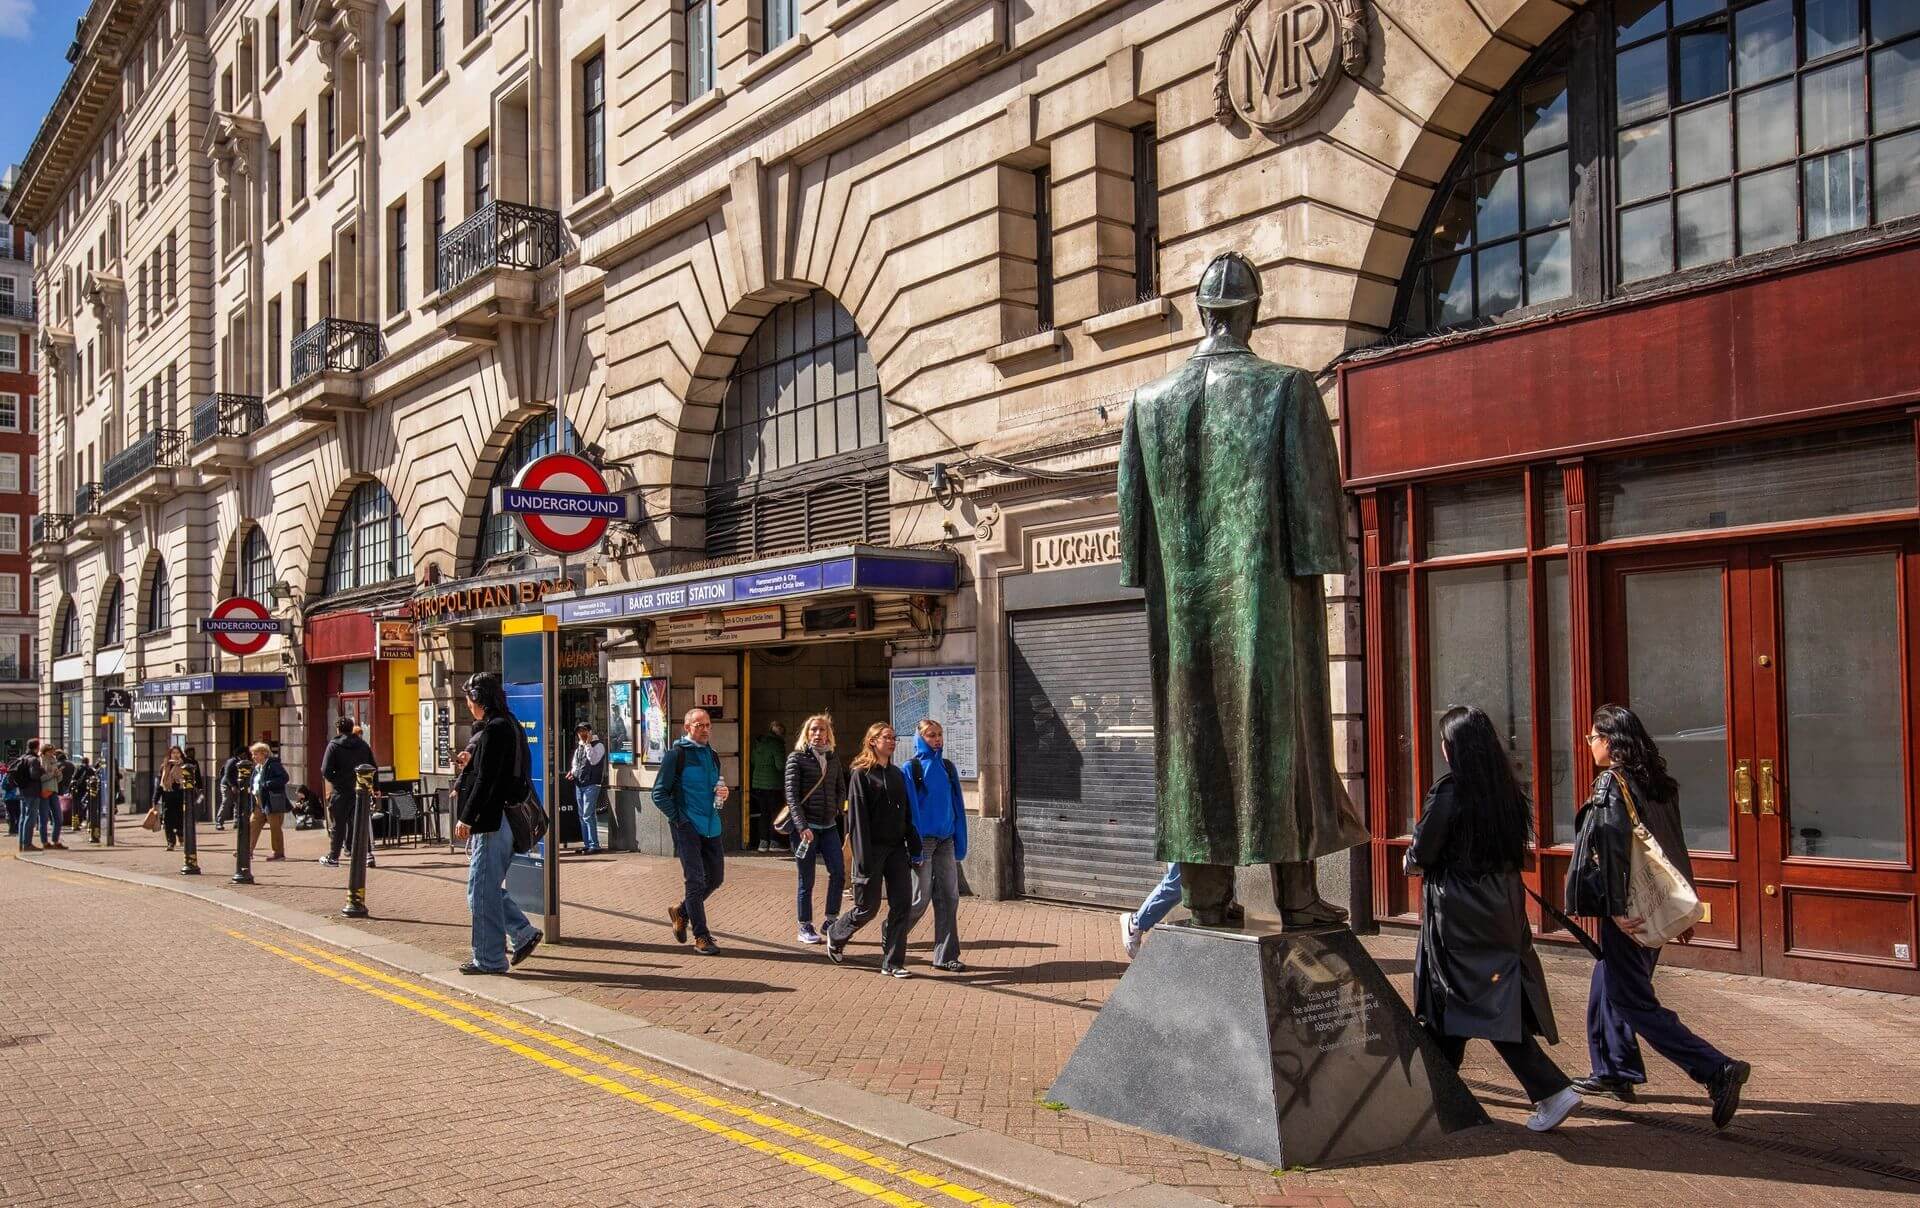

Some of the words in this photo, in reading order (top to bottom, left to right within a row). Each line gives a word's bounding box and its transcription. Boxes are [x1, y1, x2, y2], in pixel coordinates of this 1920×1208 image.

[510, 495, 619, 513] UNDERGROUND
[756, 575, 782, 586] Hammersmith
[788, 573, 797, 582] City
[749, 586, 774, 594] Metropolitan
[782, 582, 794, 590] Circle
[629, 595, 653, 610] BAKER
[657, 590, 686, 607] STREET
[689, 584, 726, 601] STATION
[206, 622, 278, 630] UNDERGROUND
[568, 670, 582, 685] and
[702, 694, 718, 706] LFB
[1314, 1022, 1334, 1032] Abbey
